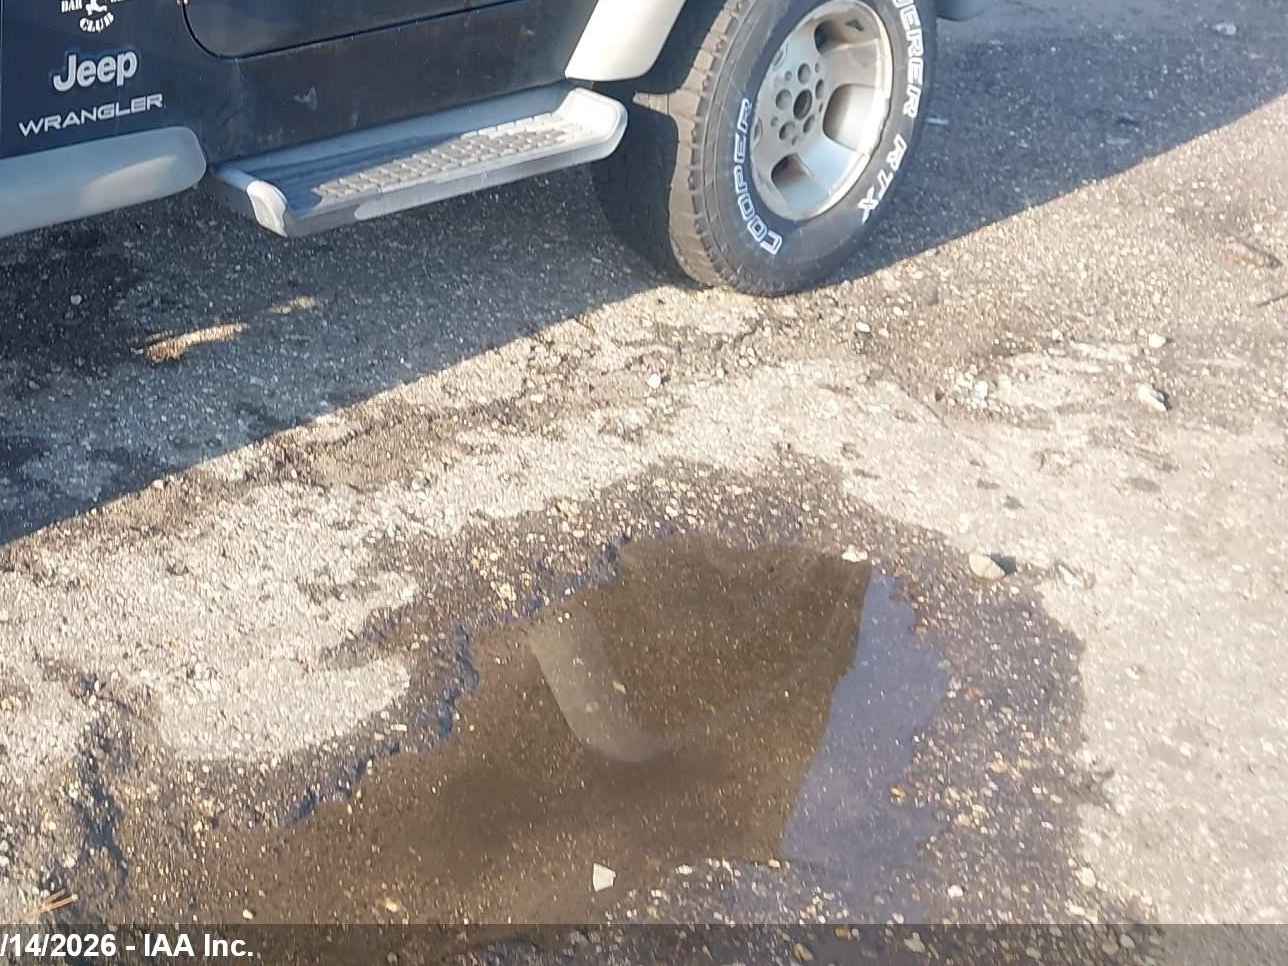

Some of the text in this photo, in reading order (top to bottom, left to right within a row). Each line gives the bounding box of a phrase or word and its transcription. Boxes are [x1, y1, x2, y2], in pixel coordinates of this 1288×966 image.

[79, 12, 114, 33] CLUB
[52, 50, 138, 92] Jeep
[18, 93, 164, 137] WRANGLER
[733, 97, 783, 255] COOPER
[857, 133, 907, 223] RTX
